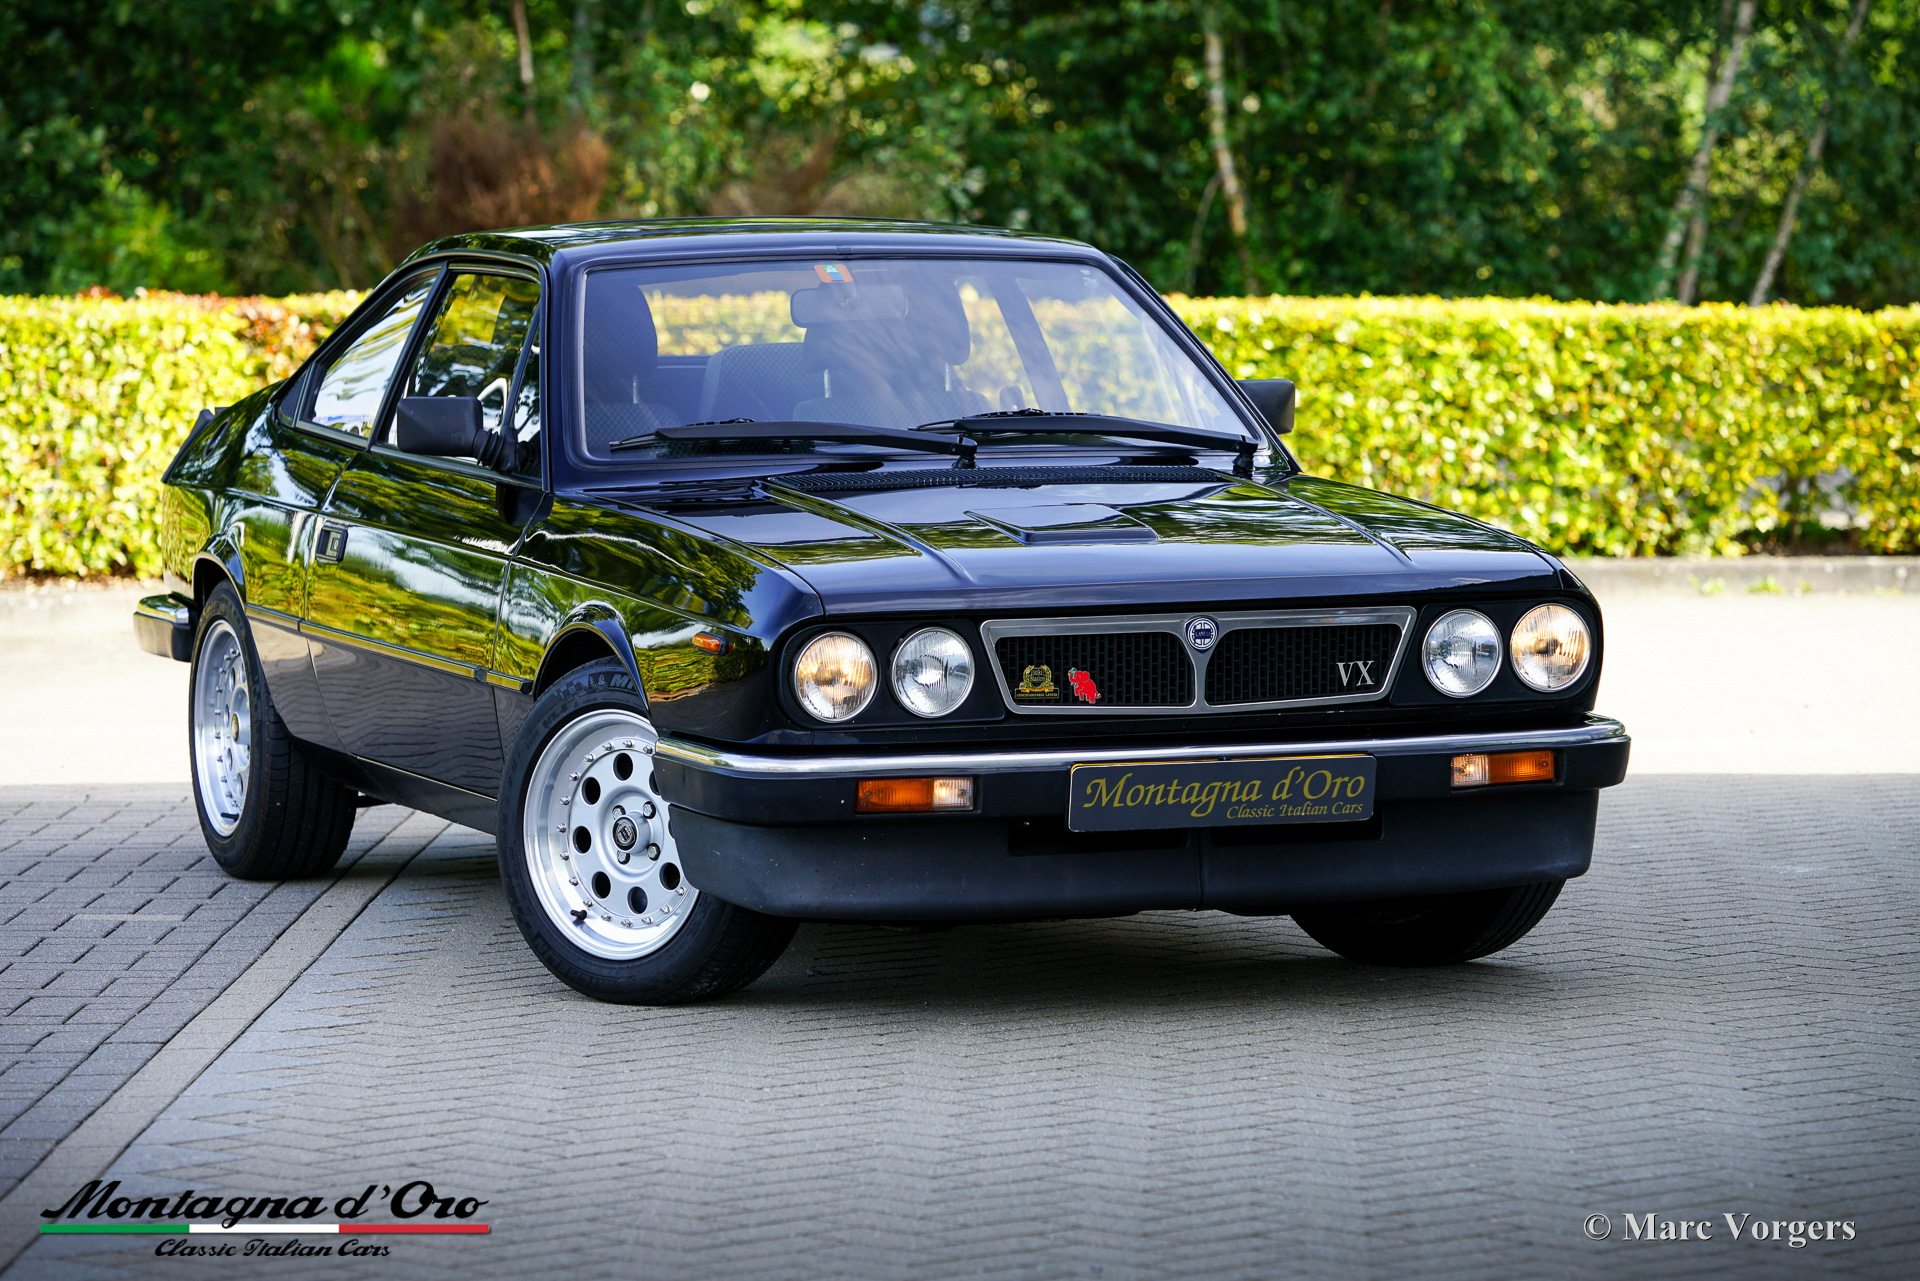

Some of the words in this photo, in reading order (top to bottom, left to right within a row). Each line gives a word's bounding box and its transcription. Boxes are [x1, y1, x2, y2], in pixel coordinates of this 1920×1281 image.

[1336, 660, 1375, 687] VX
[1083, 773, 1263, 817] Montagna
[1272, 766, 1366, 801] d'Oro
[1227, 805, 1275, 819] Classic
[1279, 802, 1328, 817] Italian
[1331, 801, 1364, 815] Cars
